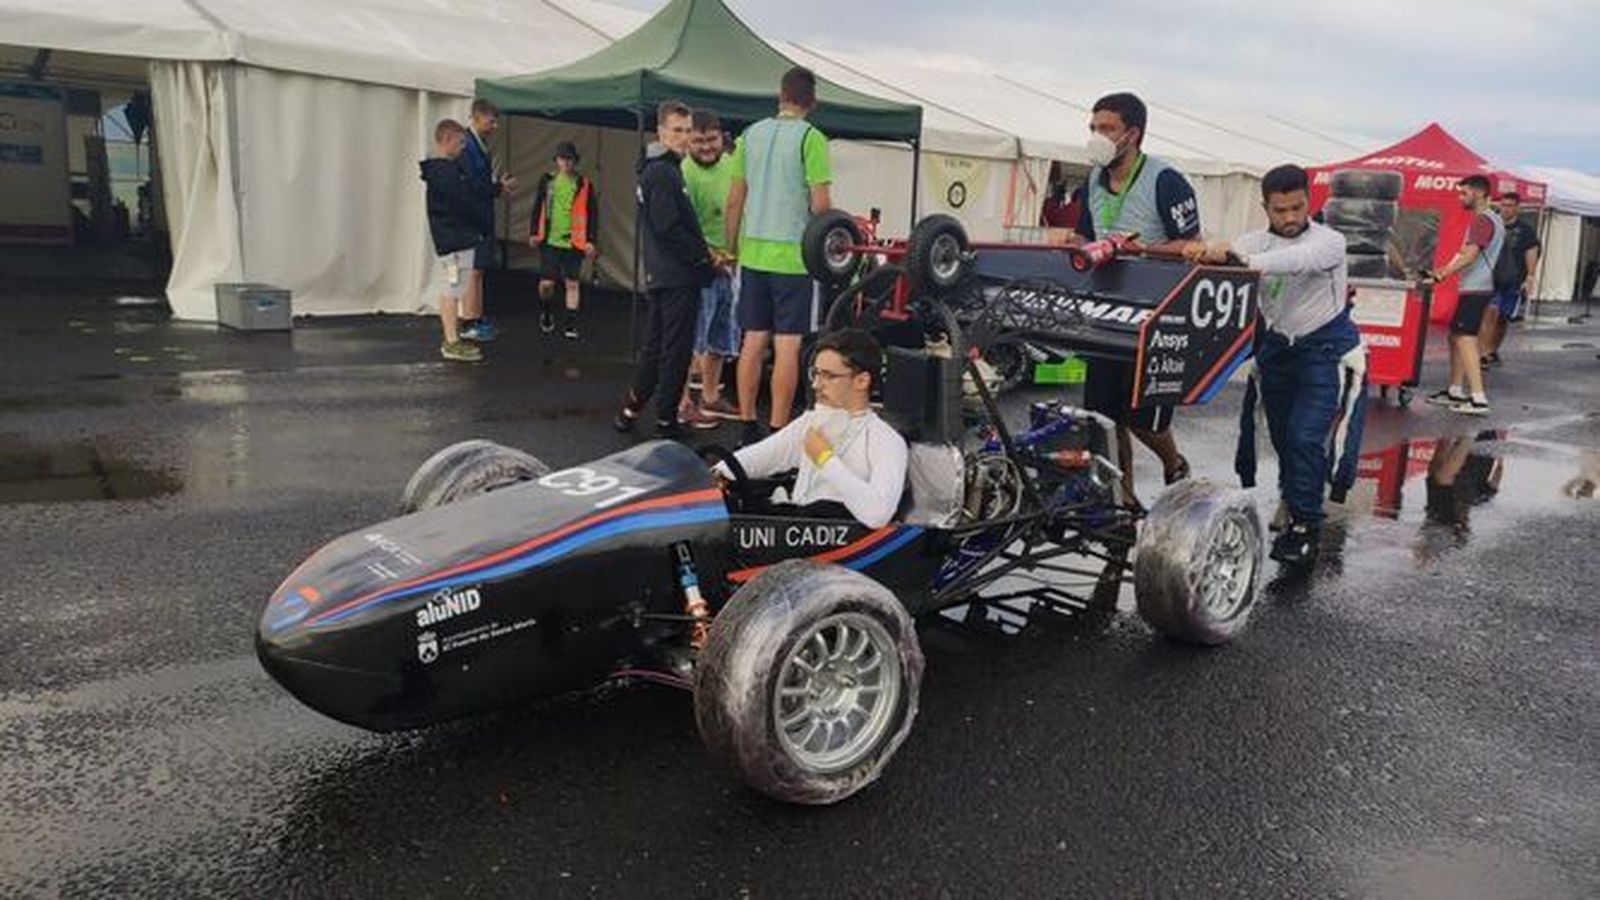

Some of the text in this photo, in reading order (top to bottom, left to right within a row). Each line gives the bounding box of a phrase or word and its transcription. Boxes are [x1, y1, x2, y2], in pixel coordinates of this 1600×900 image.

[1191, 278, 1252, 328] C91
[538, 467, 647, 509] C91
[740, 526, 849, 548] UNI CADIZ
[416, 588, 481, 627] aluNID
